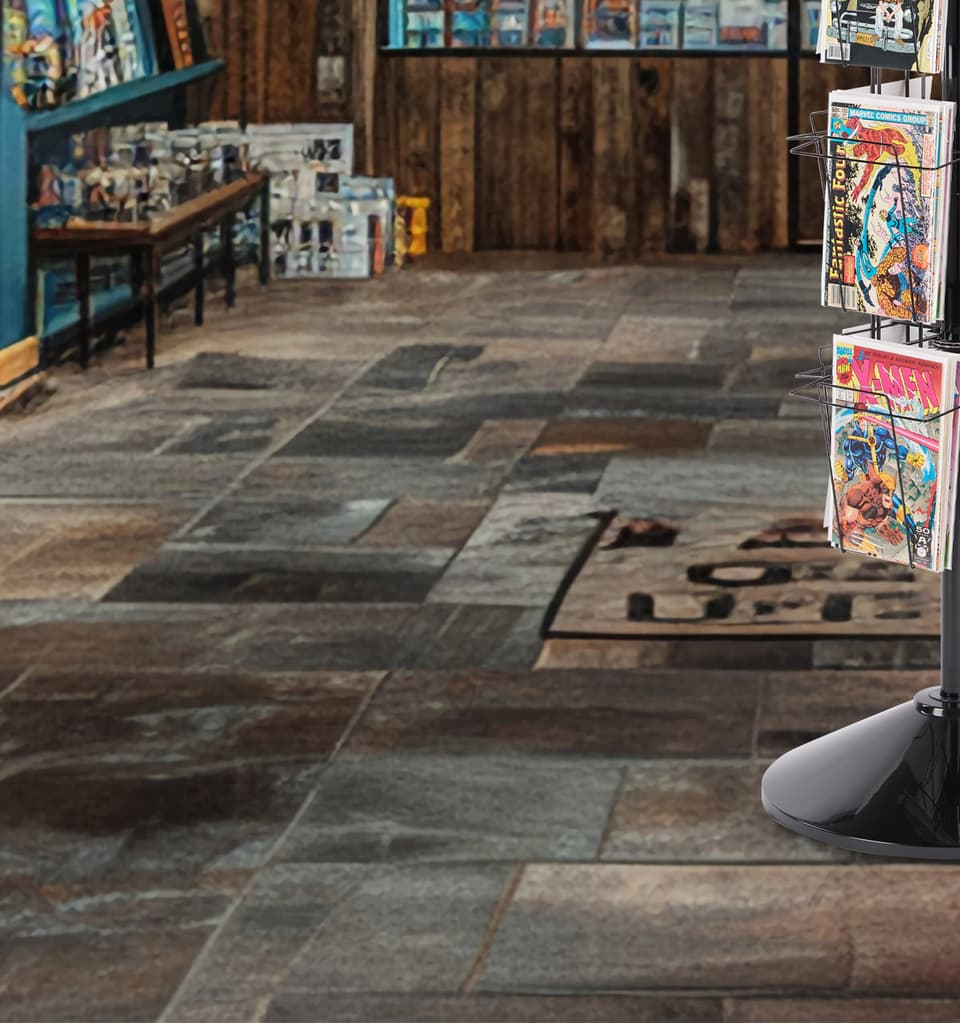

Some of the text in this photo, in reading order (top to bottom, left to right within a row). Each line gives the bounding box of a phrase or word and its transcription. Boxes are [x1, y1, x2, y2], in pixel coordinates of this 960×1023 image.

[848, 108, 875, 120] MARVEL
[875, 112, 901, 122] COMICS
[851, 358, 940, 415] X-MEN
